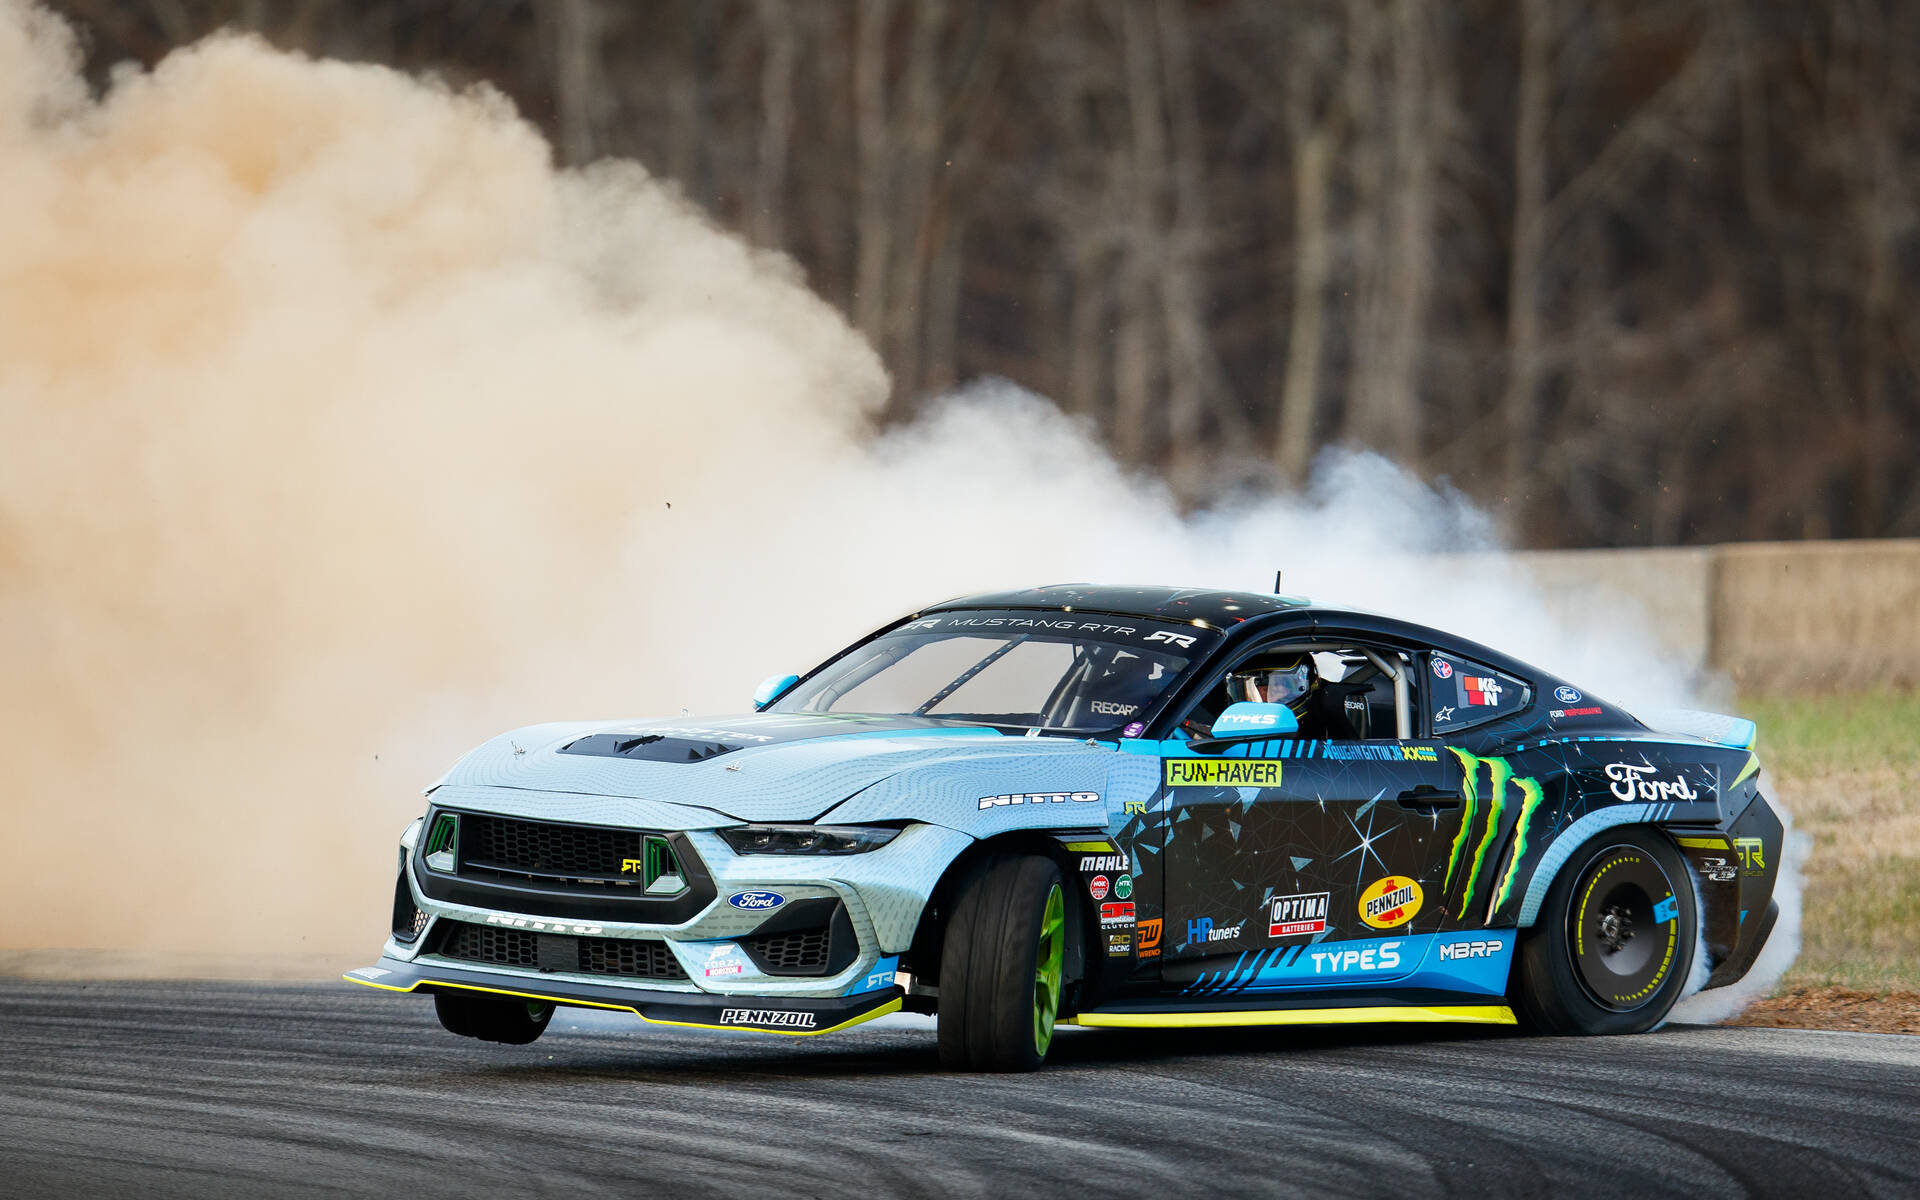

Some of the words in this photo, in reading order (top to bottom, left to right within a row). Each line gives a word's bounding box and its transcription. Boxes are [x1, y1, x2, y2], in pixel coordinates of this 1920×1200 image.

[948, 618, 1077, 629] MUSTANG
[1078, 622, 1137, 636] RTR
[1559, 688, 1578, 700] Ford
[1091, 701, 1139, 715] RECAR
[1549, 709, 1565, 719] FORD
[1170, 763, 1278, 783] FUN-HAVER
[1604, 763, 1698, 802] Ford
[978, 791, 1100, 811] NITTO
[1079, 854, 1130, 872] MAHLE
[738, 893, 775, 907] Ford
[1273, 897, 1326, 921] OPTIMA
[1366, 885, 1413, 919] PENNZOIL
[486, 913, 603, 934] NITTO
[1281, 923, 1315, 933] BATTERIES
[1109, 944, 1131, 952] RACING
[1439, 940, 1503, 962] MBRP
[704, 958, 742, 969] FORZA
[709, 966, 738, 976] HORIZON
[720, 1008, 817, 1028] PENNZOIL
